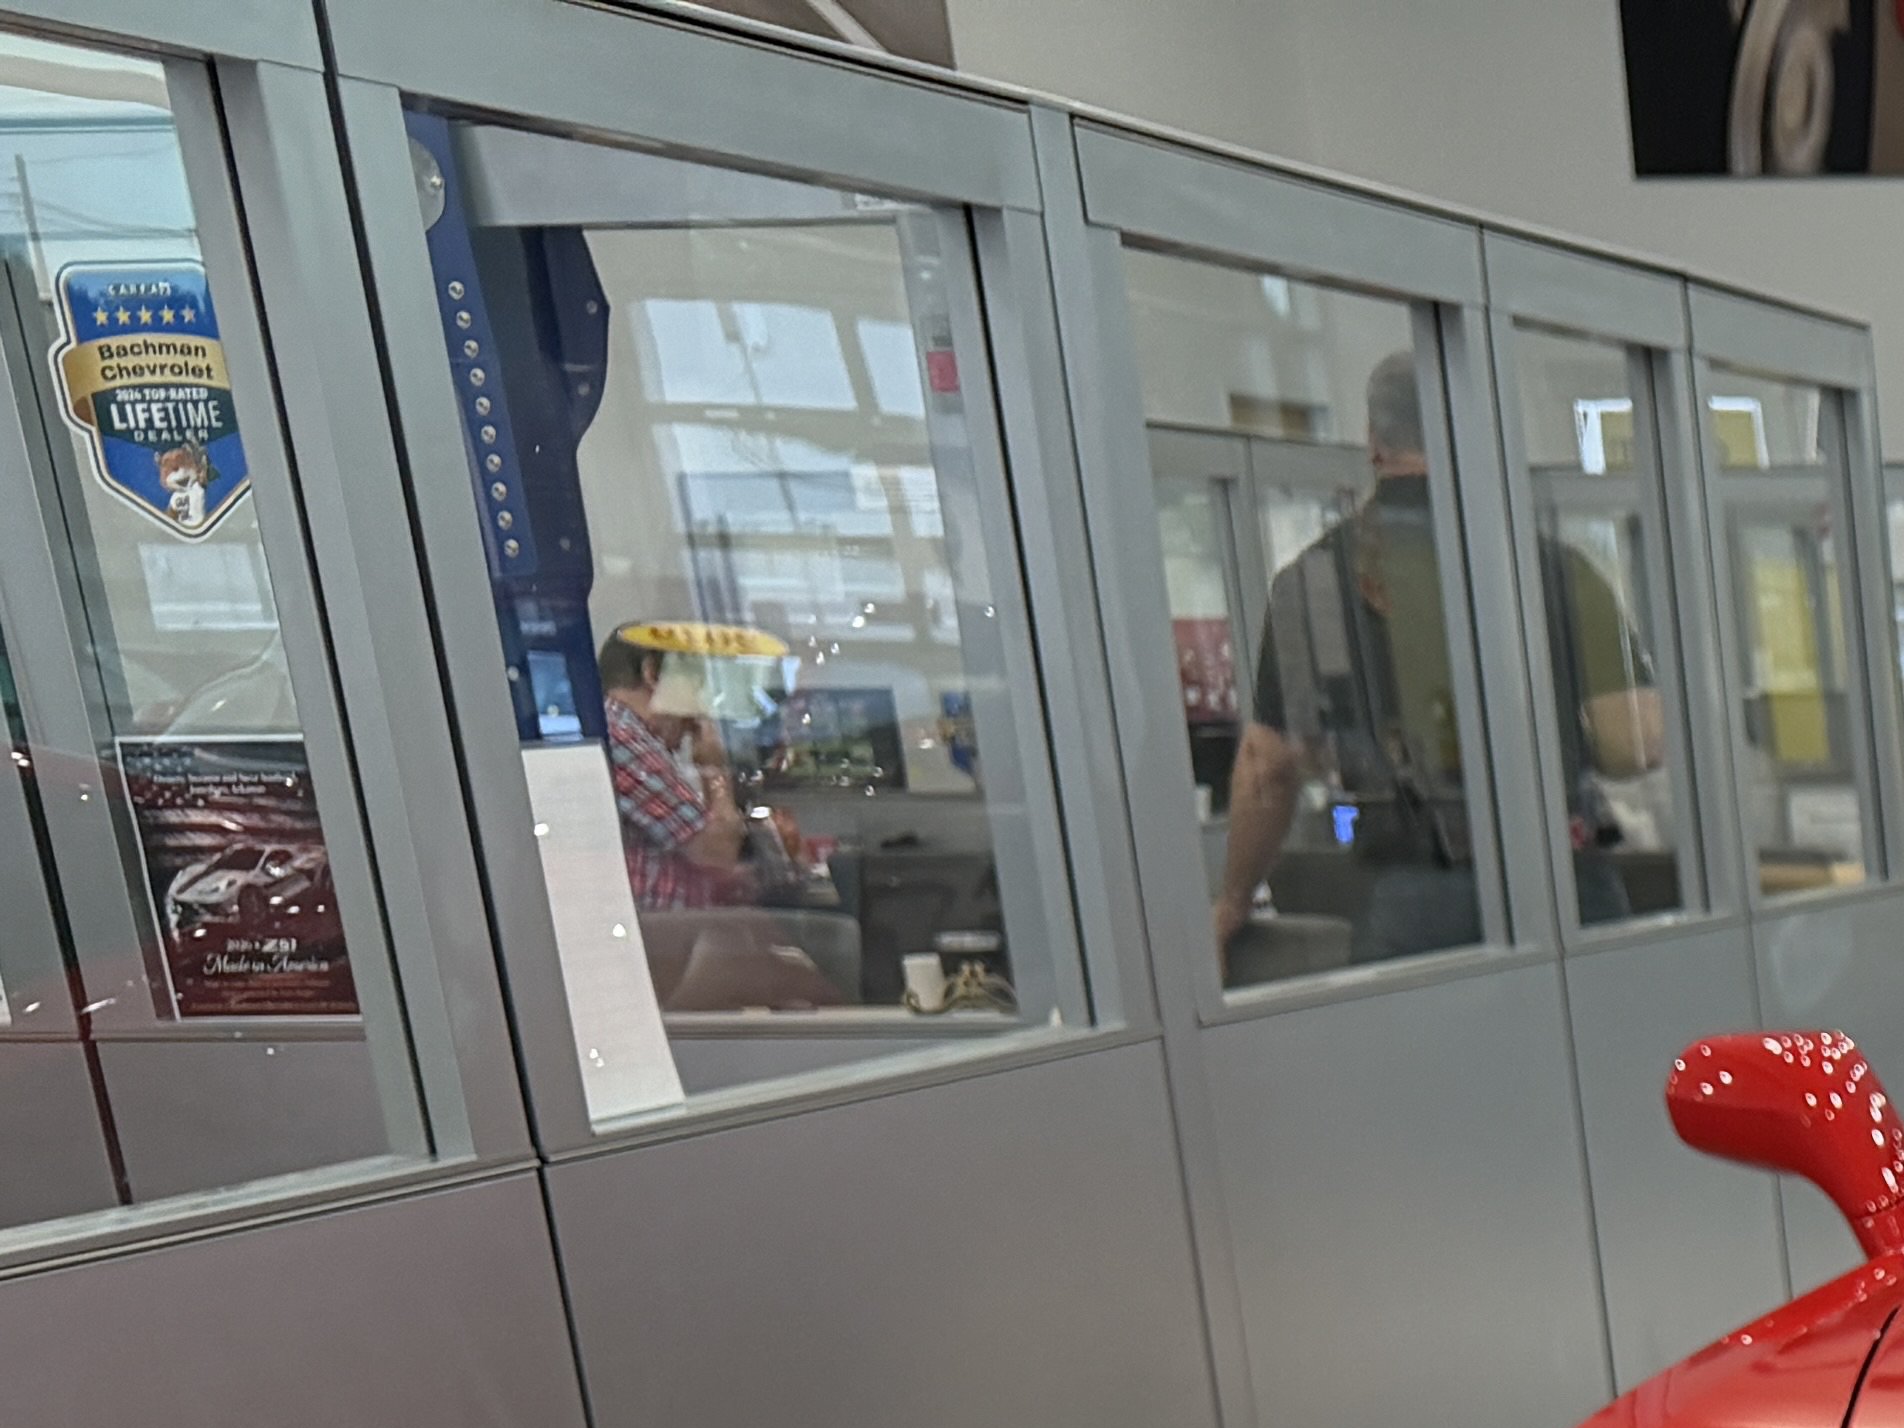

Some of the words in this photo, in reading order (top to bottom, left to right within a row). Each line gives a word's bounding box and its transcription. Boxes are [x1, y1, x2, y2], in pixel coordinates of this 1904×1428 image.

[97, 339, 207, 362] Bachman
[101, 361, 215, 382] Chevrolet
[111, 400, 223, 430] LIFETIME
[134, 428, 209, 442] DEALER
